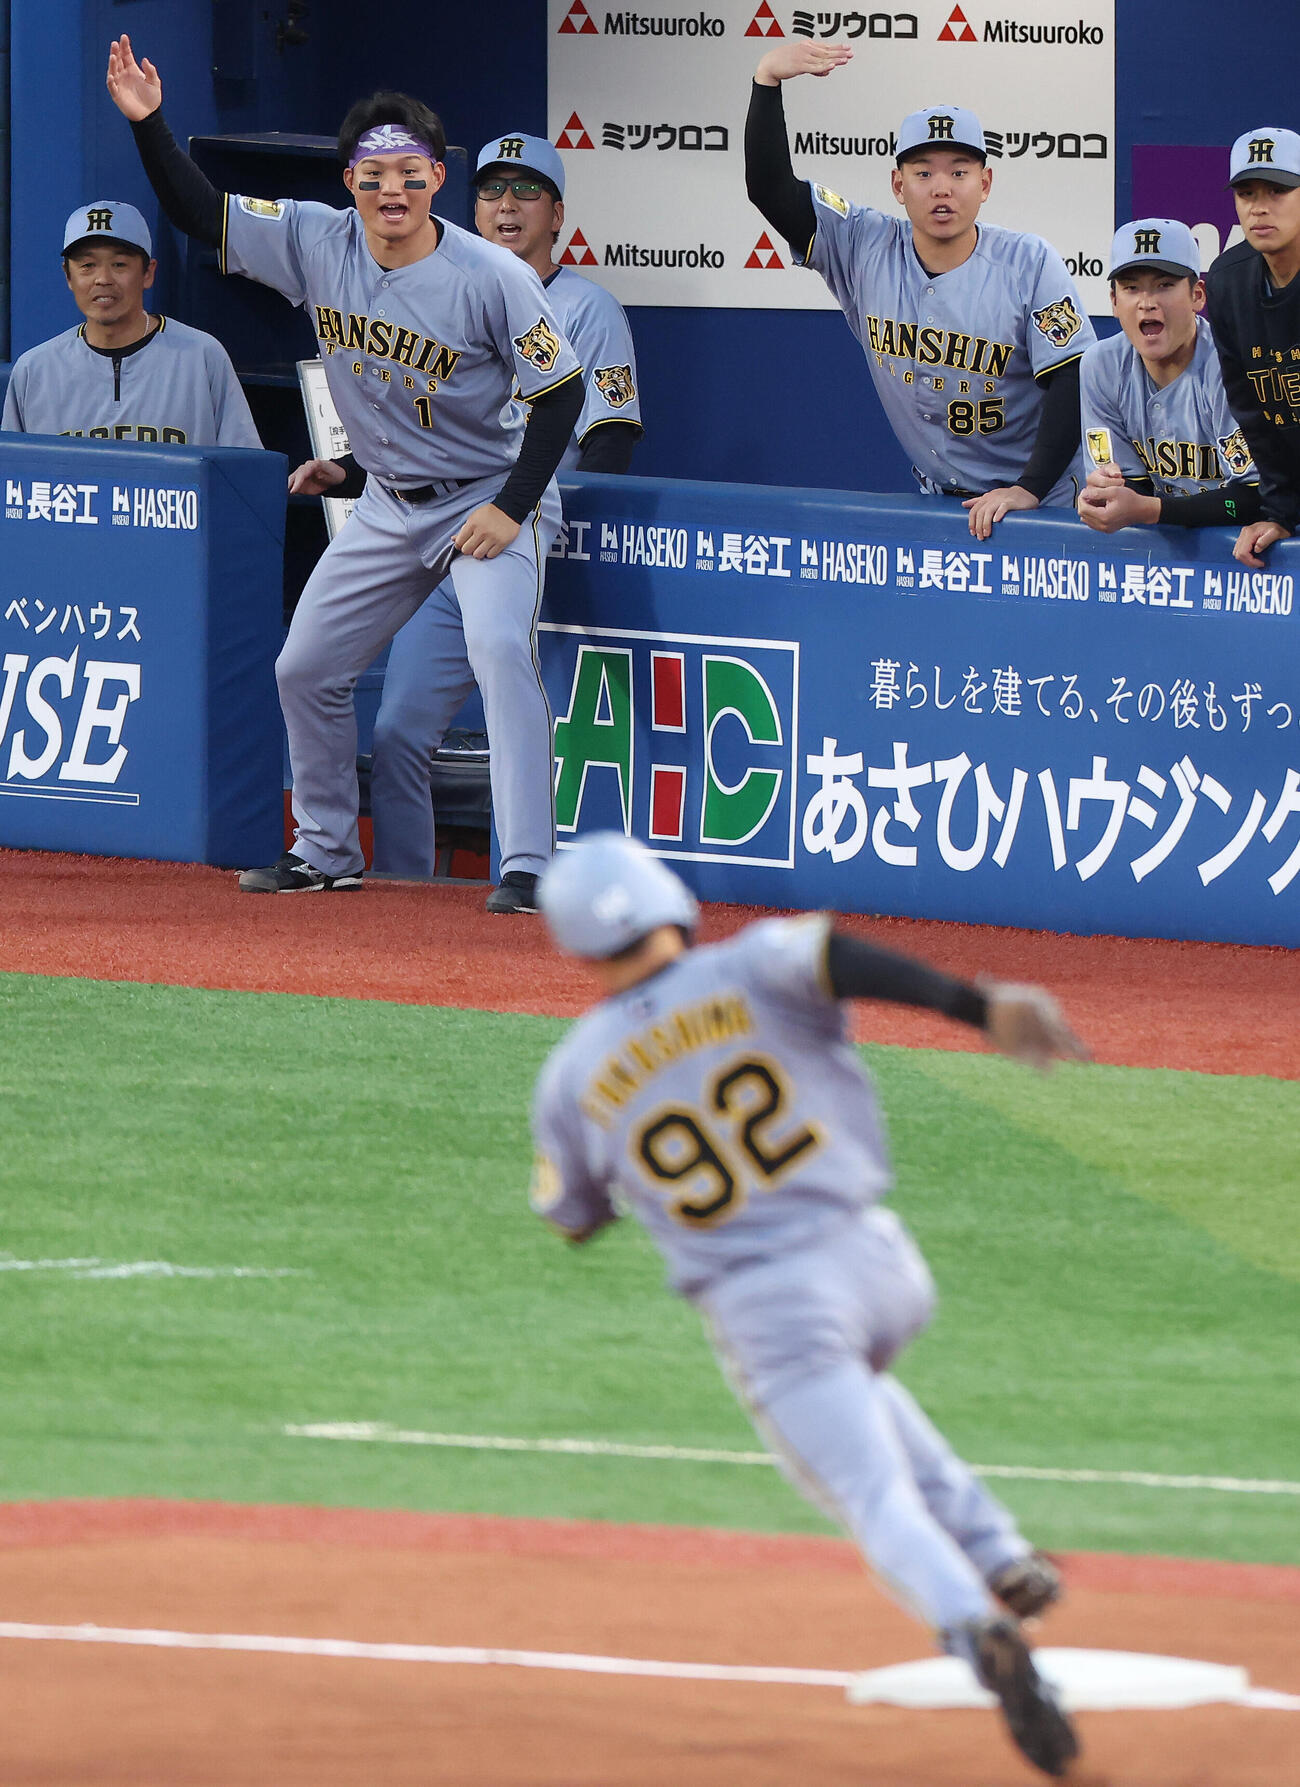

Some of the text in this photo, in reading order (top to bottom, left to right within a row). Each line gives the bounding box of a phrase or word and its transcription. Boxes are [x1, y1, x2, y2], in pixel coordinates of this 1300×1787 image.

[604, 12, 725, 37] Mitsuuroko
[792, 10, 918, 39] ミツウロコ
[983, 20, 1104, 45] Mitsuuroko
[602, 122, 728, 151] ミツウロコ
[794, 131, 897, 156] Mitsuurok
[604, 243, 725, 269] Mitsuuroko
[1062, 252, 1103, 277] oko
[315, 304, 461, 381] HANSHIN
[866, 315, 1015, 377] HANSHIN
[413, 396, 432, 429] 1
[947, 397, 1006, 436] 85
[27, 480, 99, 525] 長谷工
[133, 486, 198, 530] HASEKO
[1224, 499, 1238, 519] 67
[548, 519, 592, 561] 谷工
[621, 524, 688, 569] HASEKO
[717, 532, 792, 578] 長谷工
[822, 541, 888, 586] HASEKO
[918, 549, 993, 594] 長谷工
[1023, 556, 1089, 601] HASEKO
[1121, 563, 1195, 609] 長谷工
[1225, 571, 1294, 616] HASEKO
[4, 597, 142, 642] ベンハウス
[868, 657, 1300, 733] 暮らしを建てる、その後もずっ
[632, 1053, 825, 1228] 92
